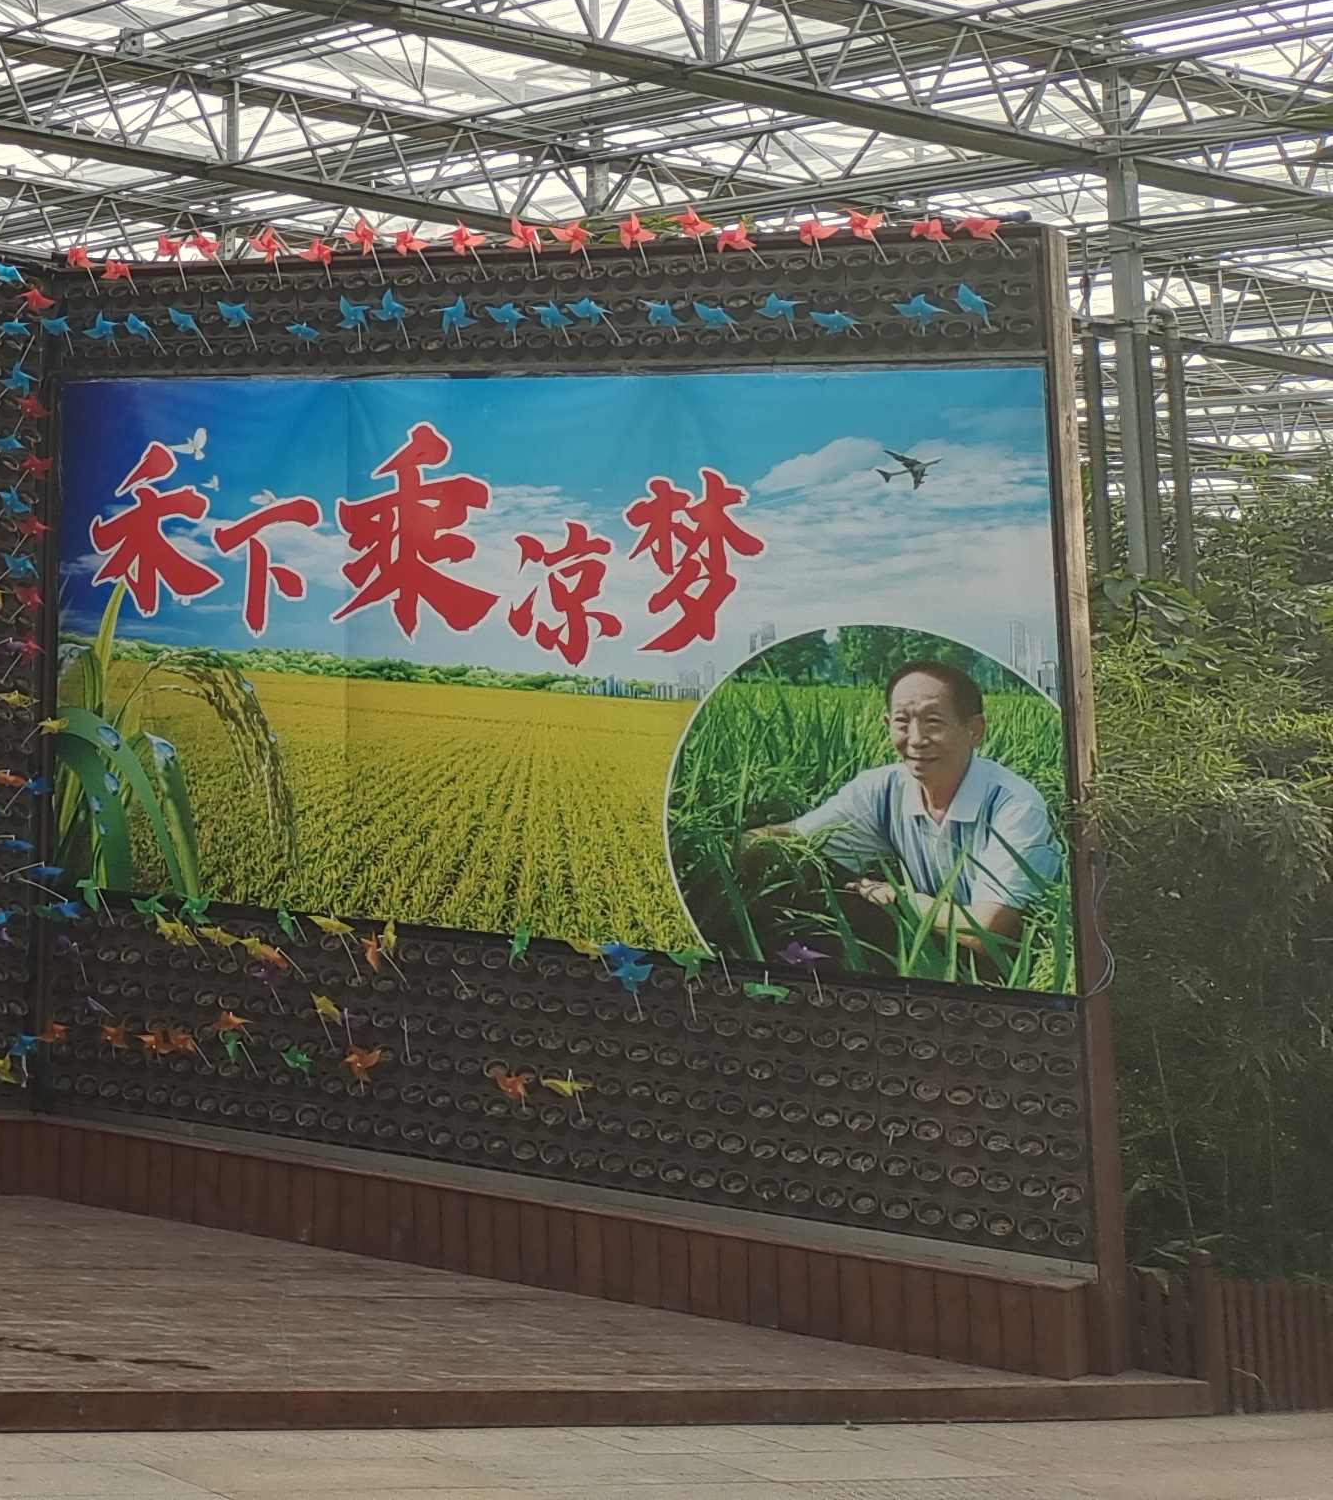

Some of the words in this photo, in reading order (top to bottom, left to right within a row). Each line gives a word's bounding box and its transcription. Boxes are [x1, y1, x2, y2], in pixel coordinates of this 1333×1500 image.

[90, 421, 765, 667] 禾下乘凉梦
